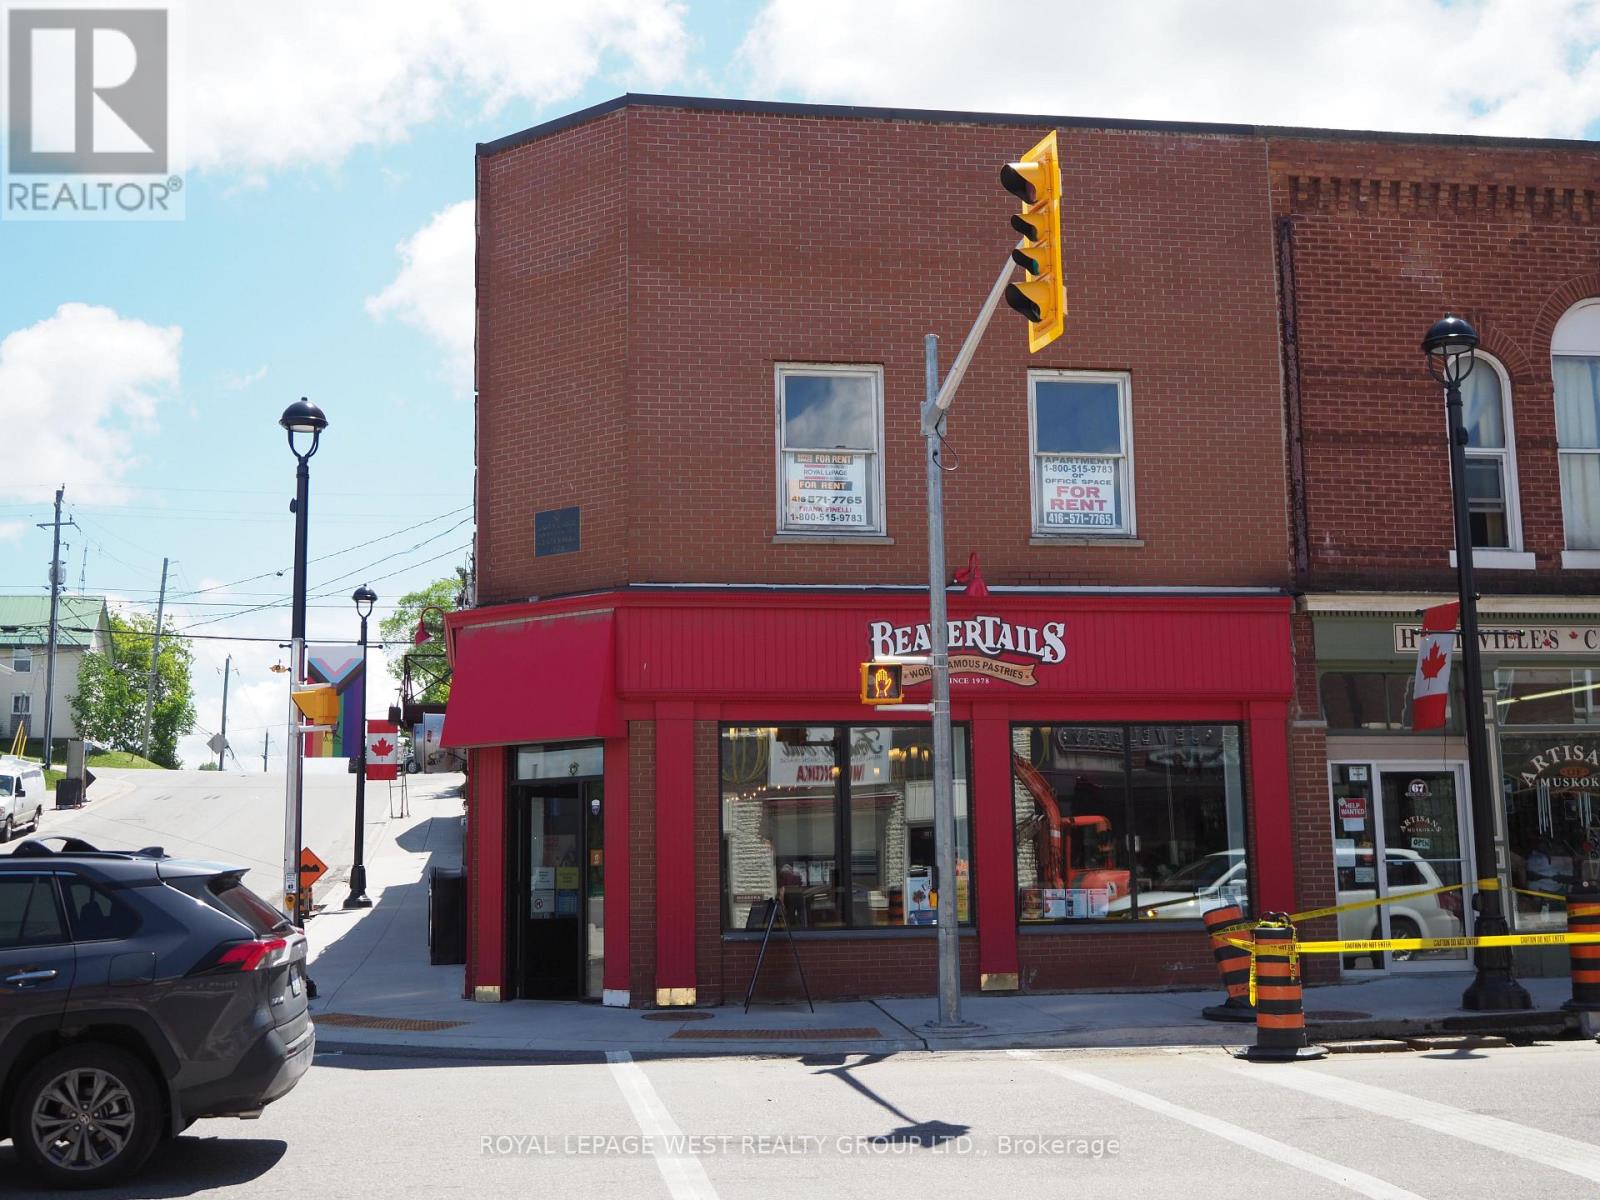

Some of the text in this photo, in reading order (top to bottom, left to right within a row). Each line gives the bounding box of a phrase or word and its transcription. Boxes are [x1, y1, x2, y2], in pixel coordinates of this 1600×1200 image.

[1044, 456, 1111, 464] APARTMENT
[1044, 465, 1113, 473] 1-800-515-9783
[799, 481, 847, 490] FOR RENT
[1056, 486, 1101, 498] FOR
[1050, 499, 1107, 511] RENT
[790, 513, 863, 522] 1-800-515-9783
[1048, 513, 1112, 525] 416-571-7765
[947, 659, 981, 669] AMOUS
[982, 661, 1024, 679] PASTRIES
[1411, 783, 1425, 793] 67
[1340, 808, 1365, 816] WANTED
